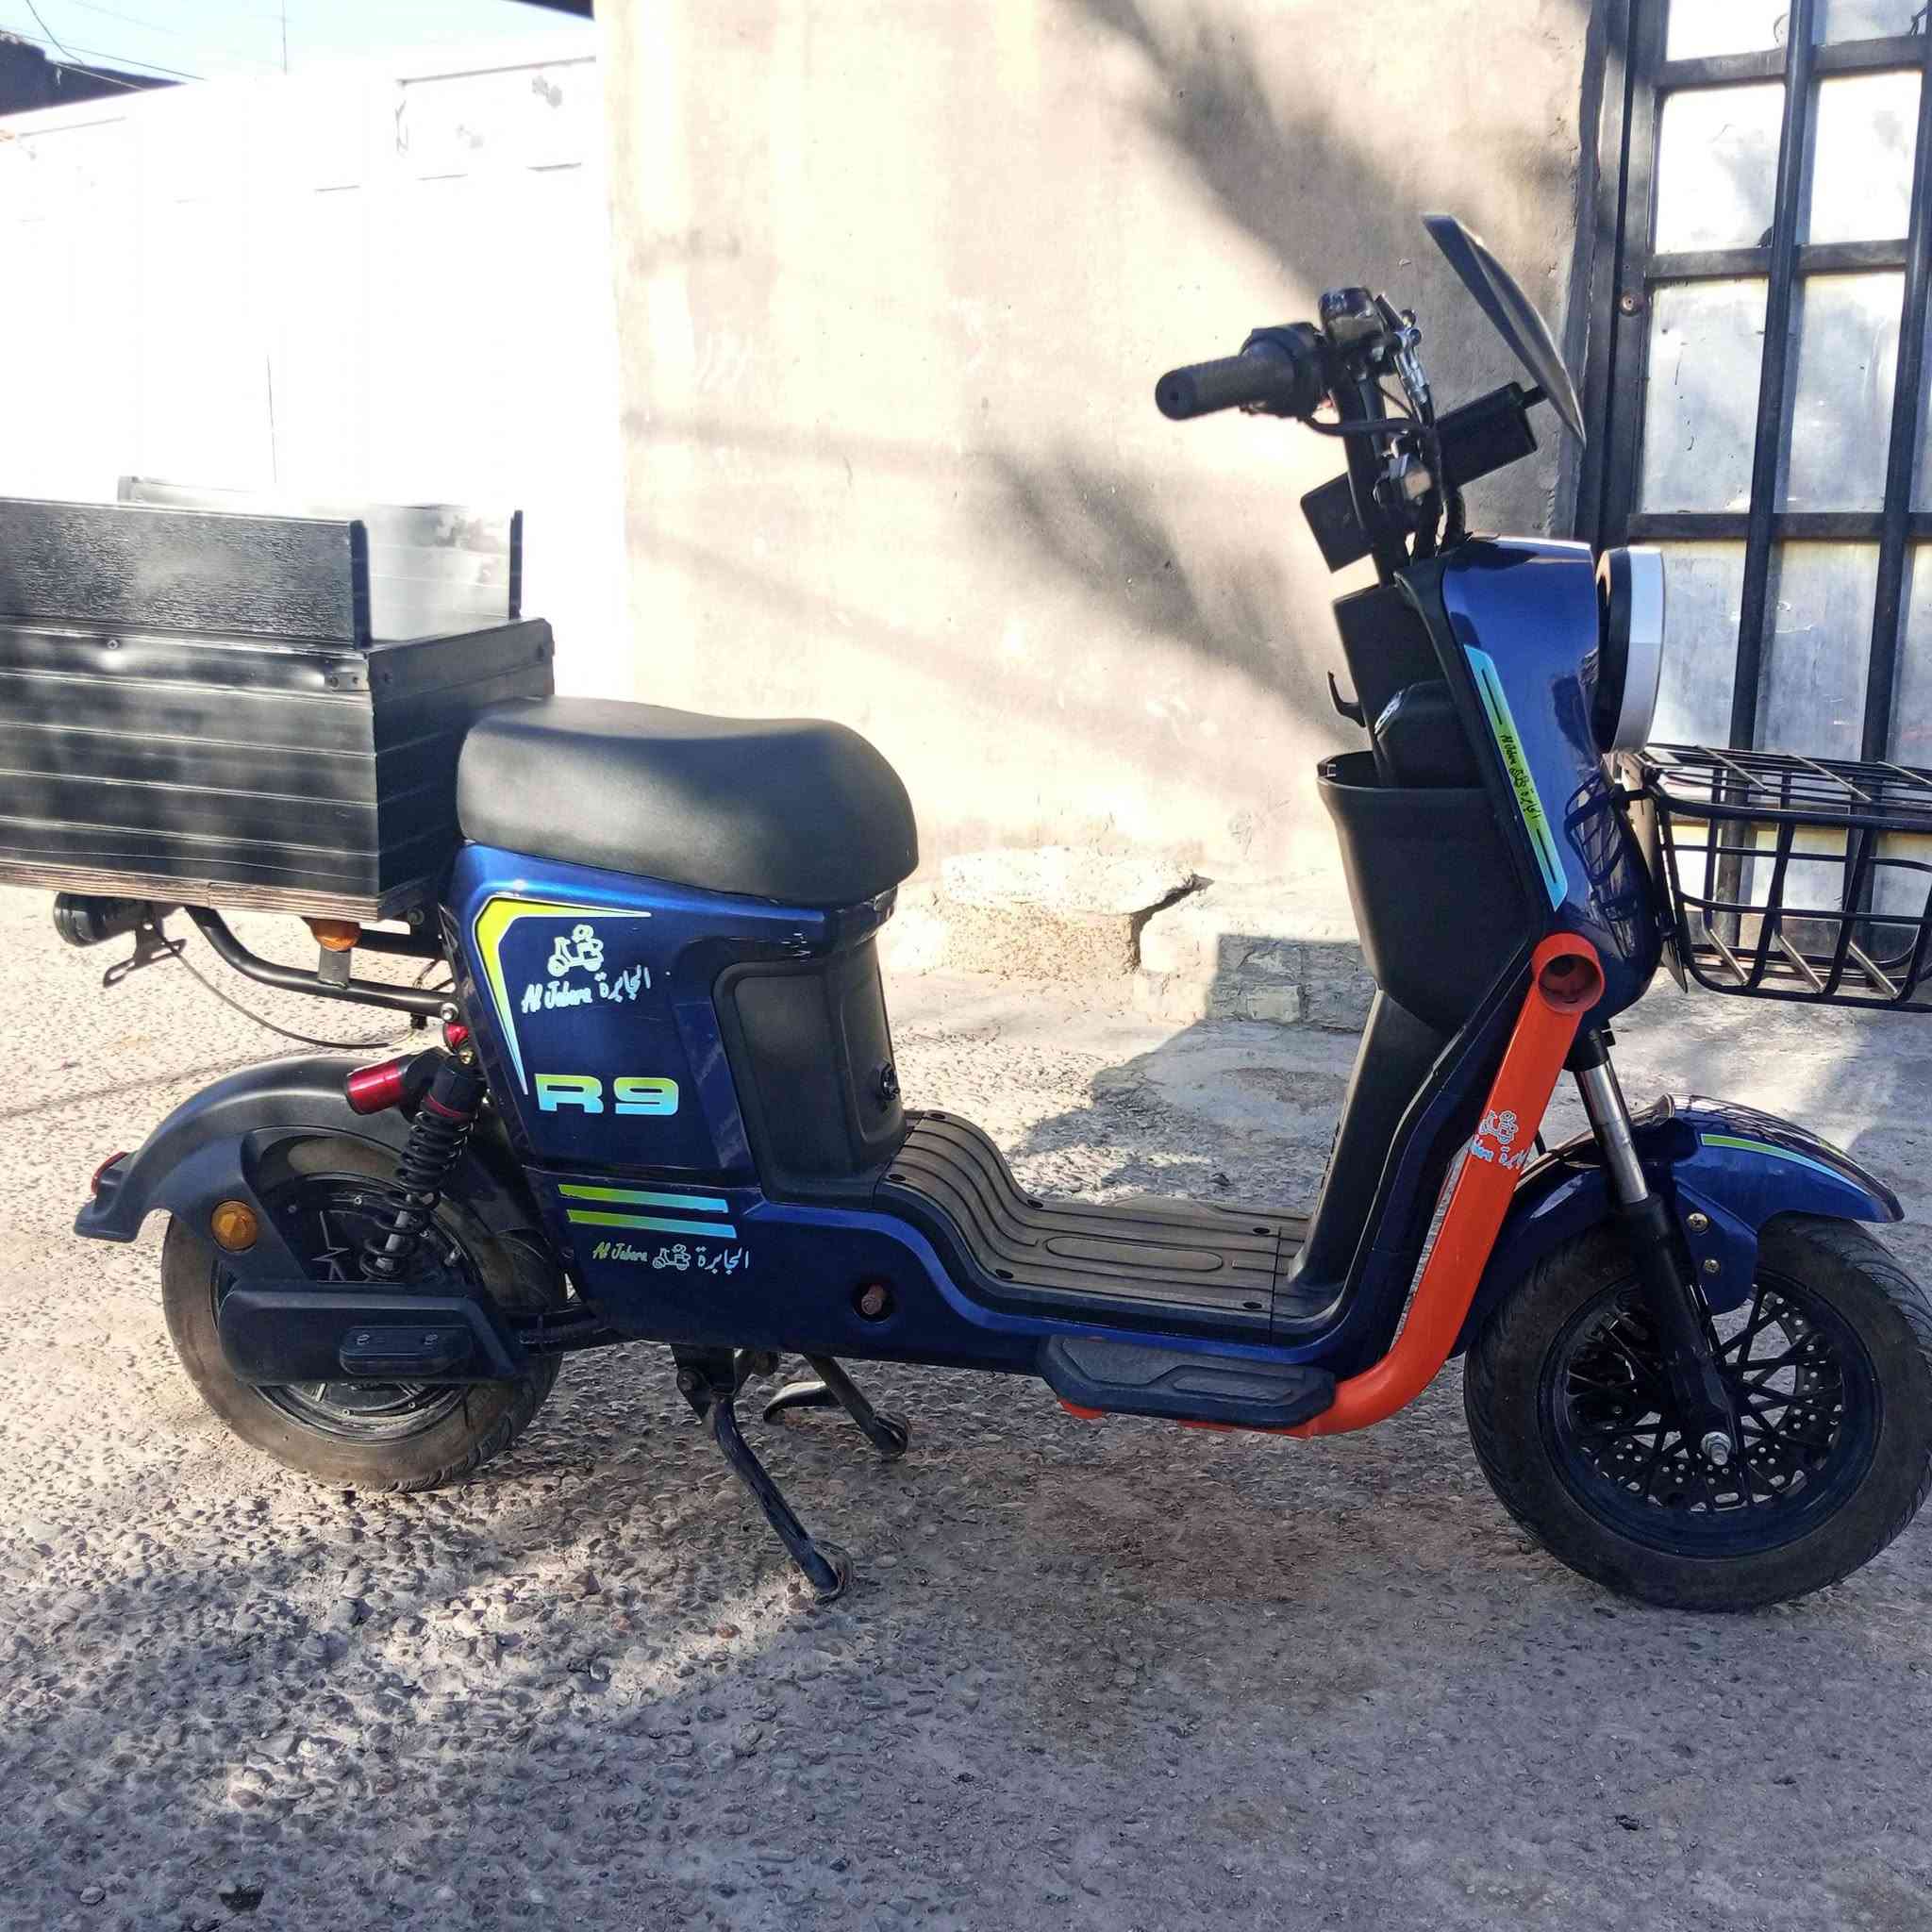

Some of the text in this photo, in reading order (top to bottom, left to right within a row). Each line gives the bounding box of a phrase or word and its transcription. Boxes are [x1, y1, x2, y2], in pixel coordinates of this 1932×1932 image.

[521, 983, 543, 1013] Al
[534, 1073, 679, 1116] R9
[592, 1241, 611, 1259] Al
